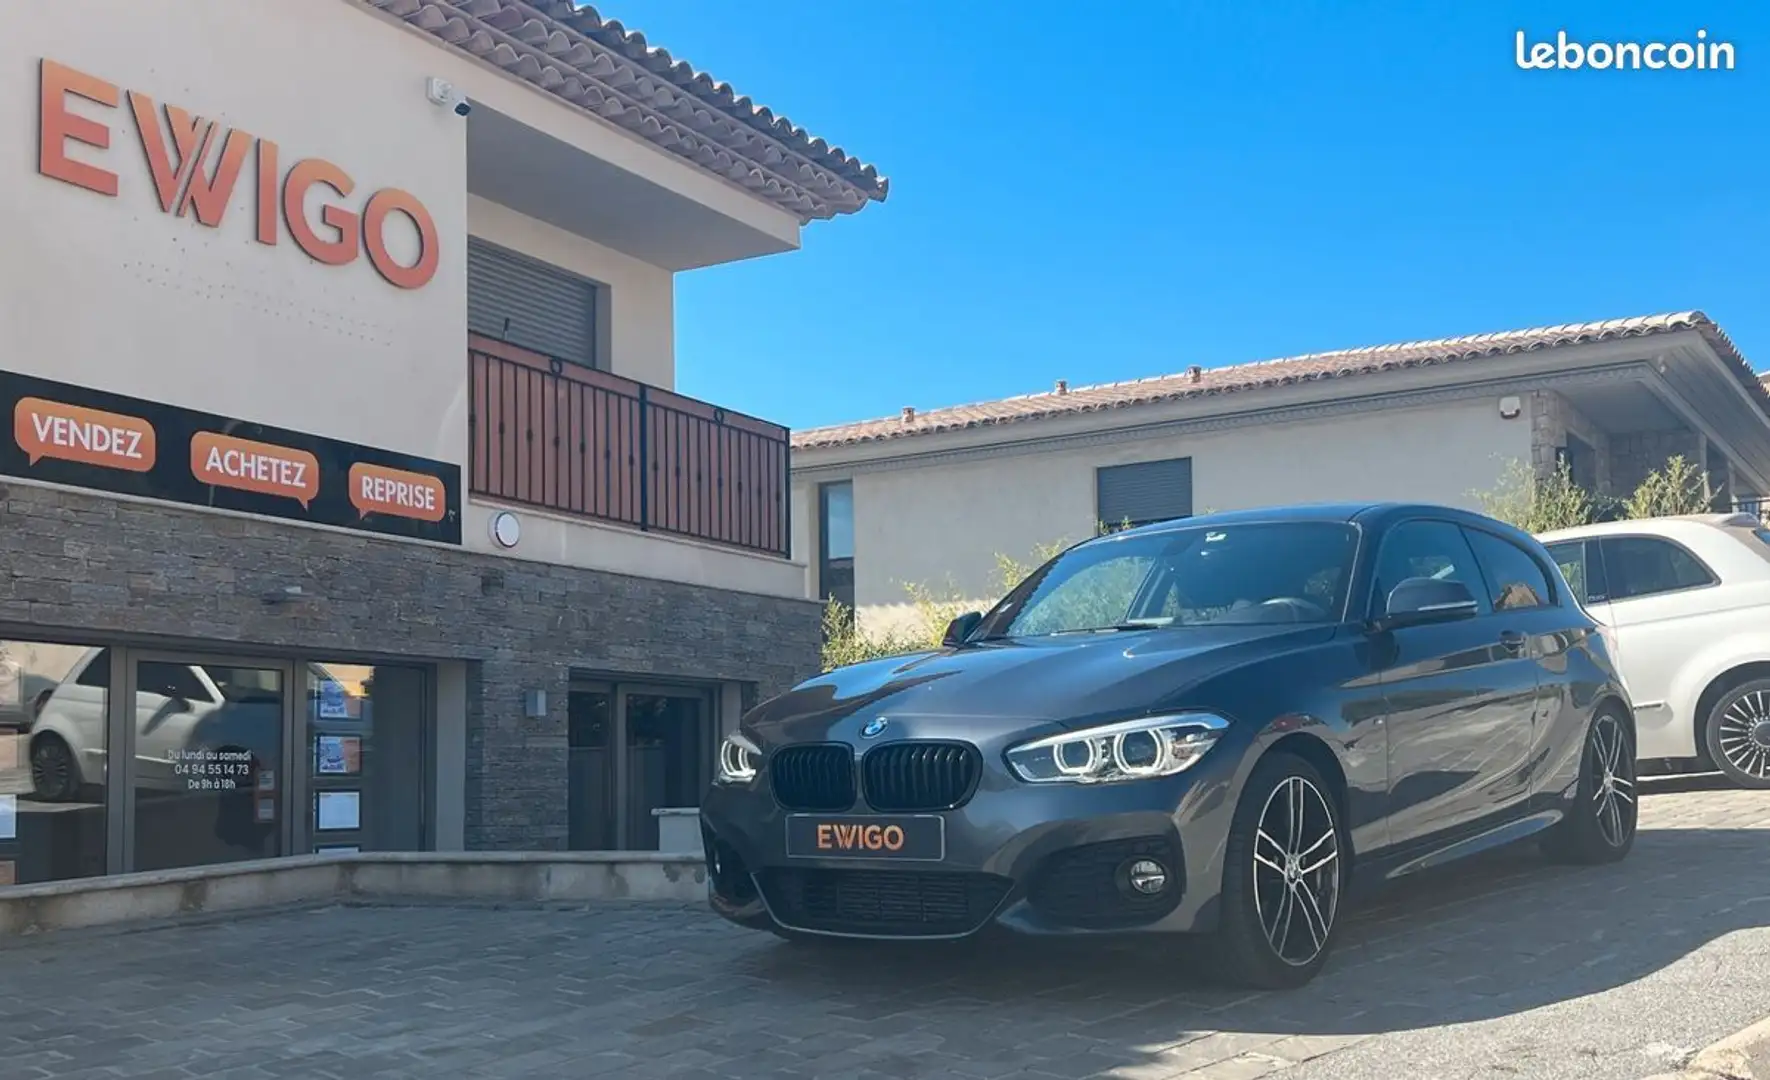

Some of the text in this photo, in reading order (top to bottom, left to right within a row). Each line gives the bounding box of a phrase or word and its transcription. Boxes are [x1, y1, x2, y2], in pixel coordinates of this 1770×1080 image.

[39, 57, 439, 289] EWIGO
[31, 412, 143, 460] VENDEZ
[205, 446, 307, 488] ACHETEZ
[361, 475, 436, 511] REPRISE
[168, 748, 252, 761] Du lundi au samedi
[175, 764, 250, 775] 04 94 55 14 73
[188, 779, 200, 789] De
[201, 779, 212, 789] 9h
[221, 779, 236, 789] 18h
[817, 824, 904, 851] EWIGO
